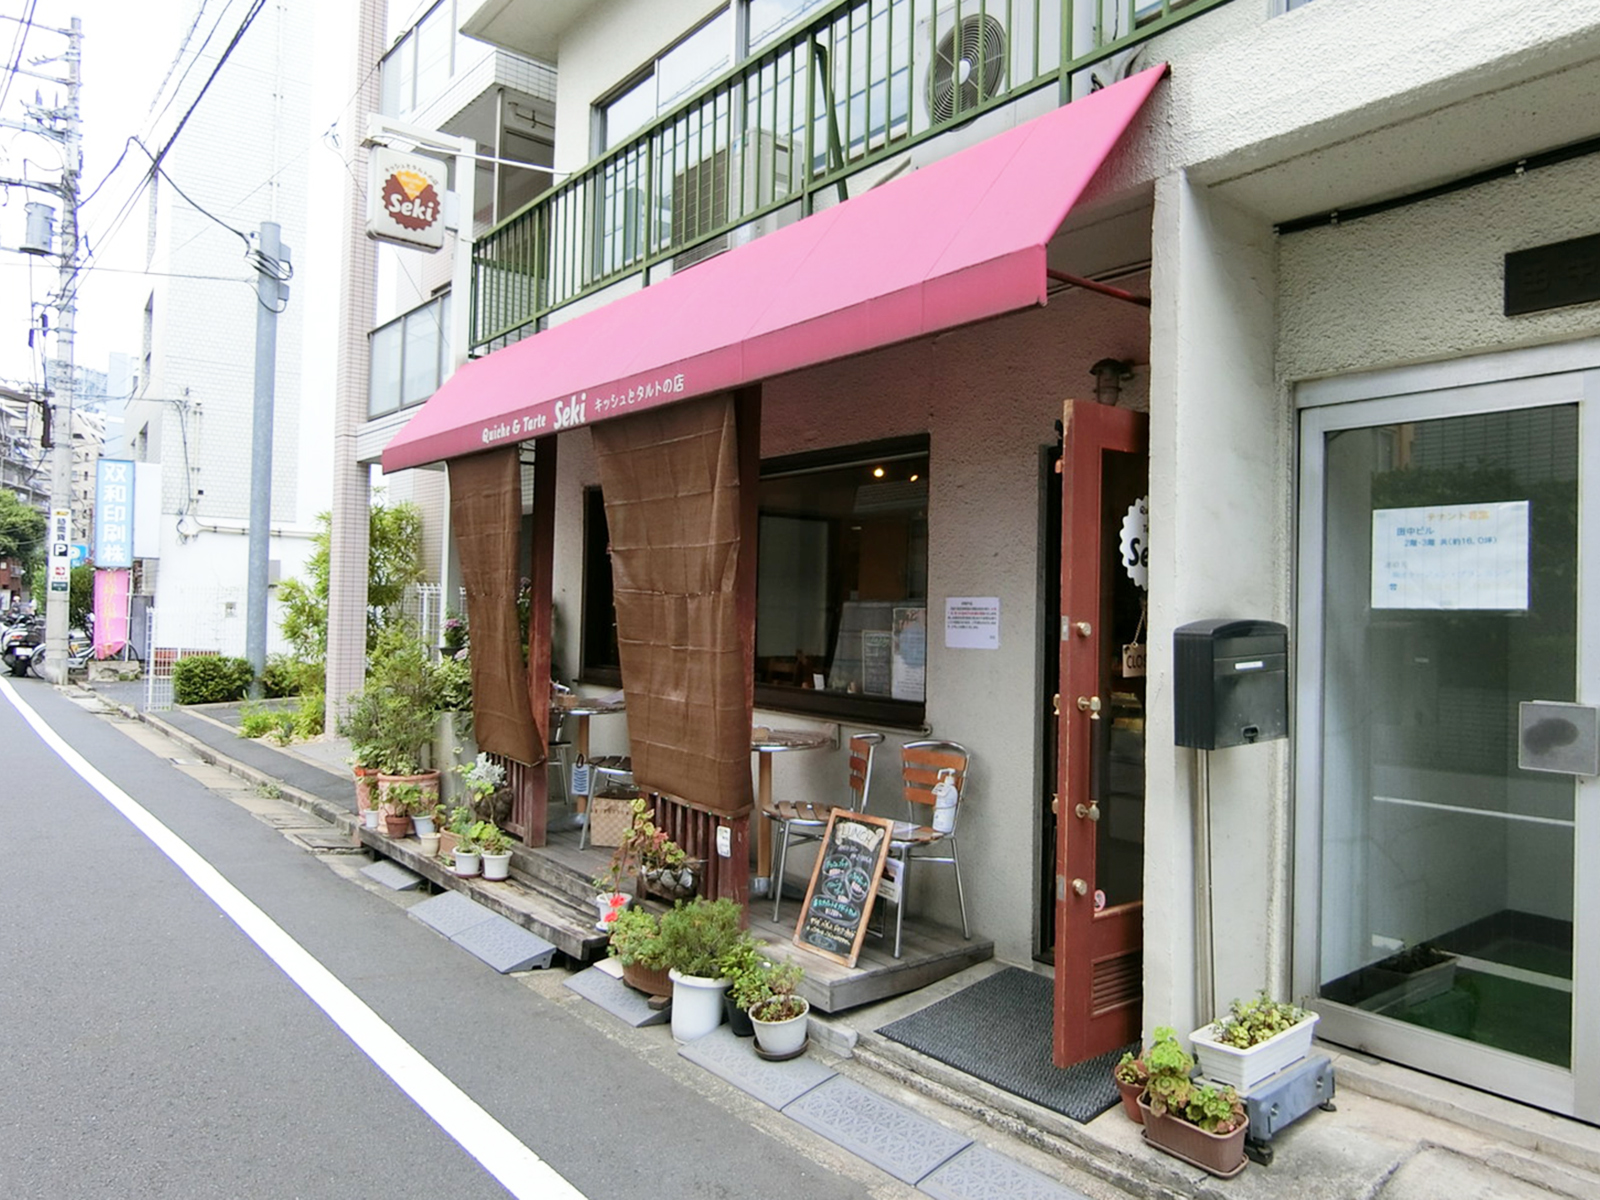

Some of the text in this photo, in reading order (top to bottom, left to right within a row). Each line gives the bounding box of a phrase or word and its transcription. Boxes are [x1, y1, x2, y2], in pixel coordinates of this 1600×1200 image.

[388, 193, 435, 222] Seki
[594, 374, 685, 412] キッシュとタルトの店
[482, 392, 587, 444] Quiche & Tarte Seki
[103, 463, 126, 562] 双和印刷株
[1396, 526, 1435, 536] 田中ビル
[55, 545, 66, 556] P
[841, 824, 871, 846] LUNCH
